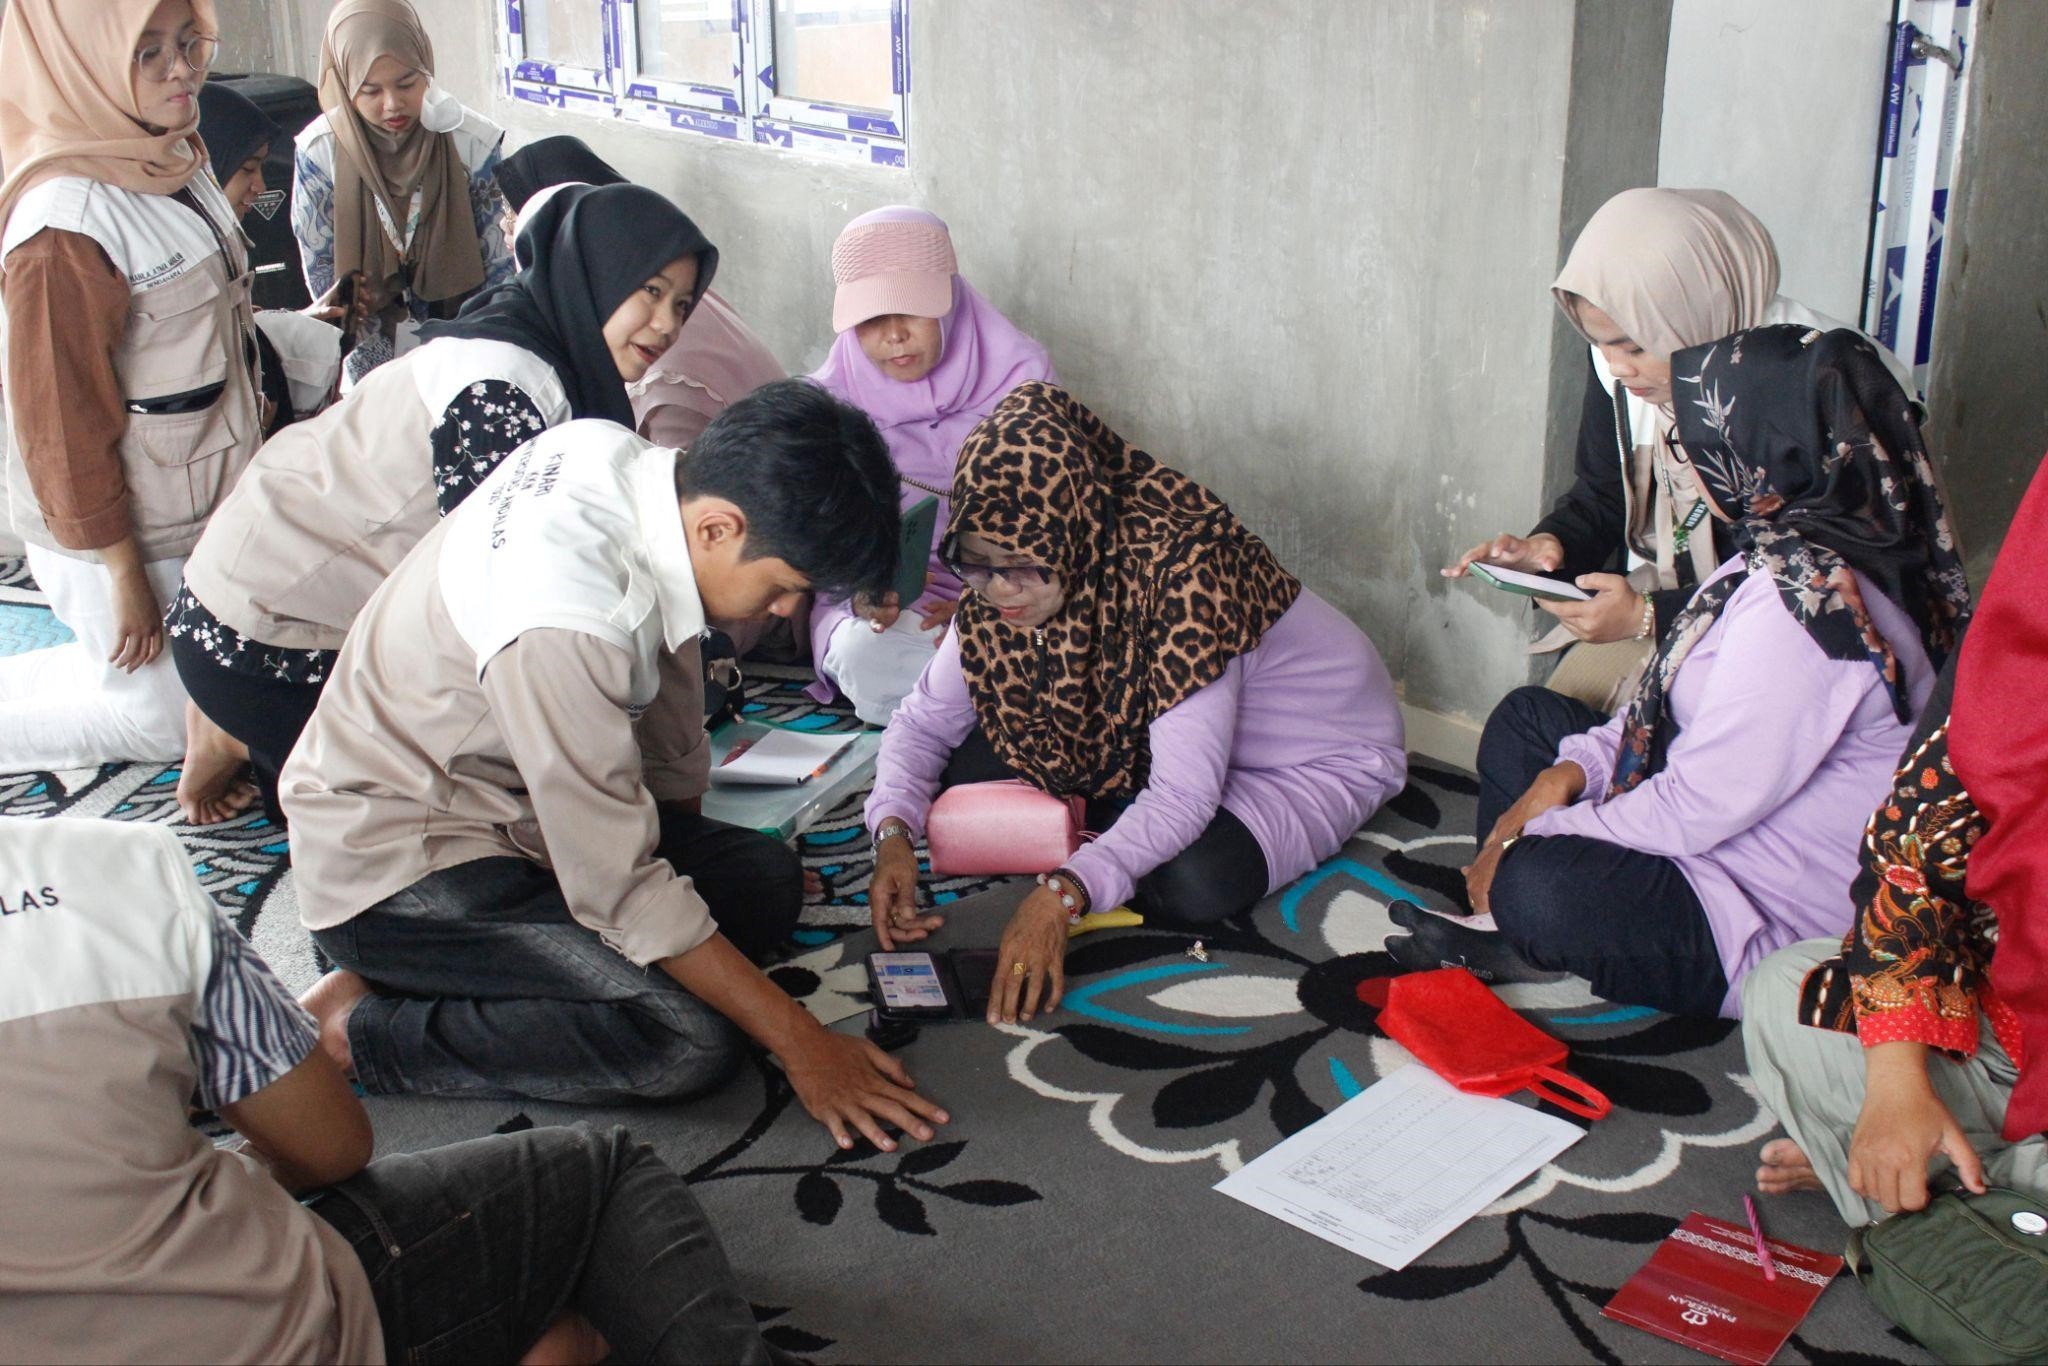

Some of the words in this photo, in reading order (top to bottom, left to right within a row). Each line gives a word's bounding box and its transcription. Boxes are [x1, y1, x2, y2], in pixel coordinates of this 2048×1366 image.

[1890, 83, 1901, 105] AW
[534, 453, 565, 497] KINARI
[492, 495, 515, 549] ANDALAS
[1684, 502, 1708, 528] KEREN
[0, 887, 59, 915] LAS
[1667, 1293, 1738, 1324] PANGERAN
